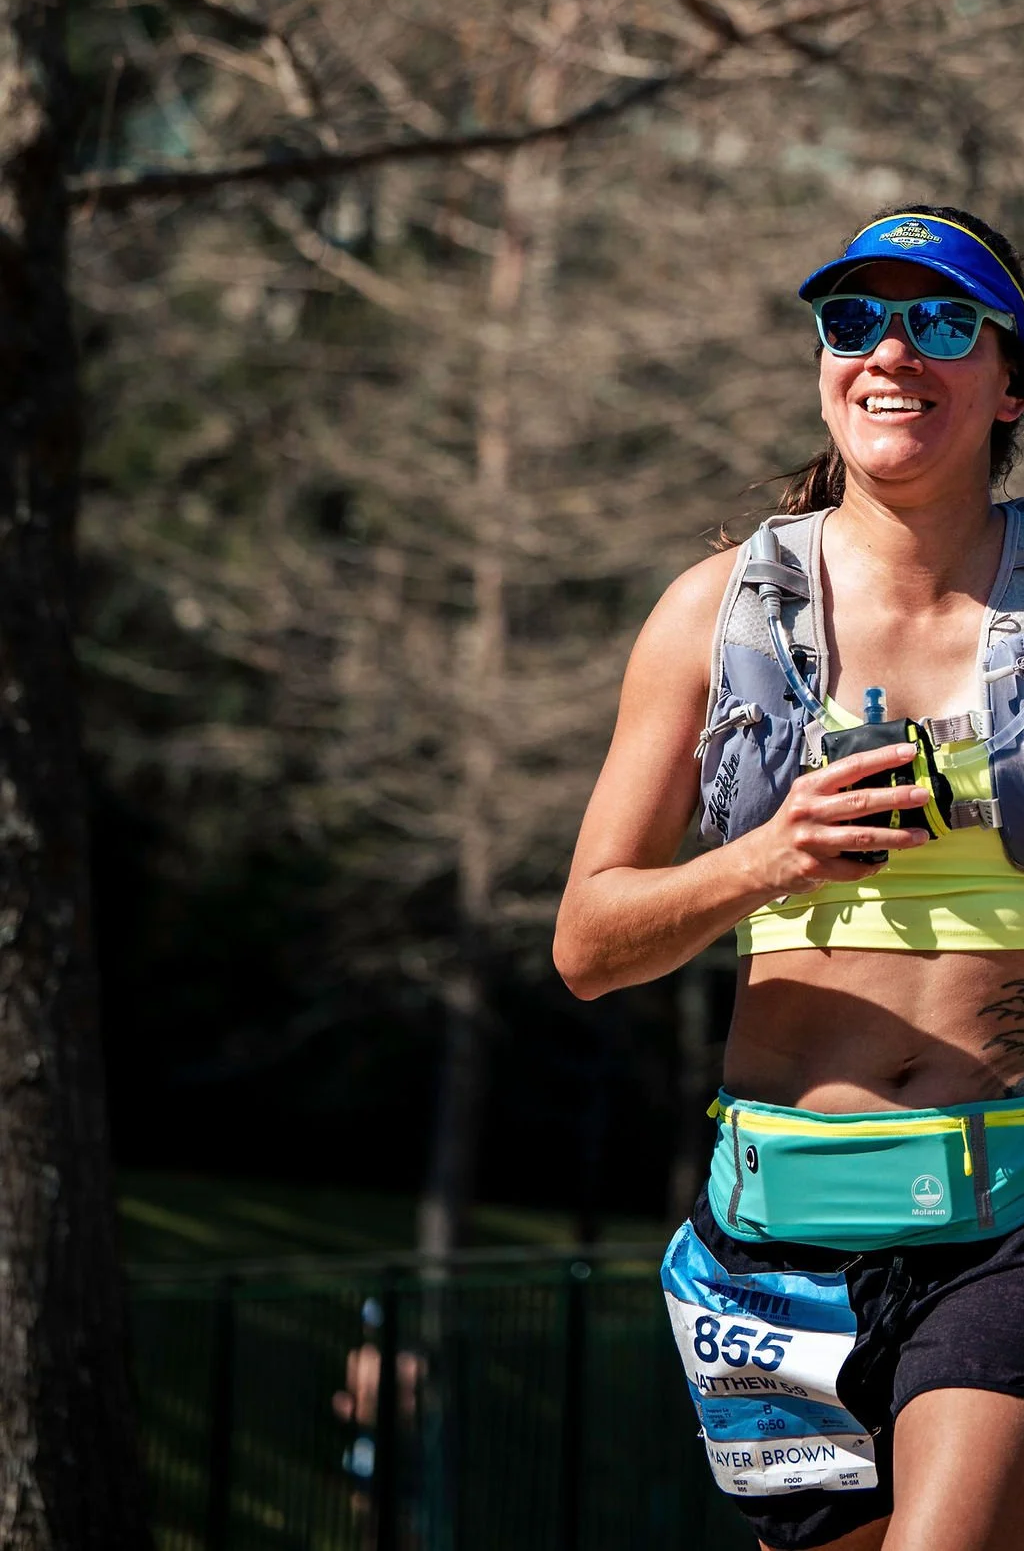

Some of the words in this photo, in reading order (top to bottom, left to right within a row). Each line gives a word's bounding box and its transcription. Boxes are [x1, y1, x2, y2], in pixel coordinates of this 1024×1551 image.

[881, 232, 941, 241] WOODLANDS
[694, 1315, 794, 1372] 855
[695, 1371, 777, 1392] ATTHEW
[780, 1381, 808, 1397] 5:9
[757, 1418, 786, 1432] 6:50
[762, 1445, 836, 1467] BROWN
